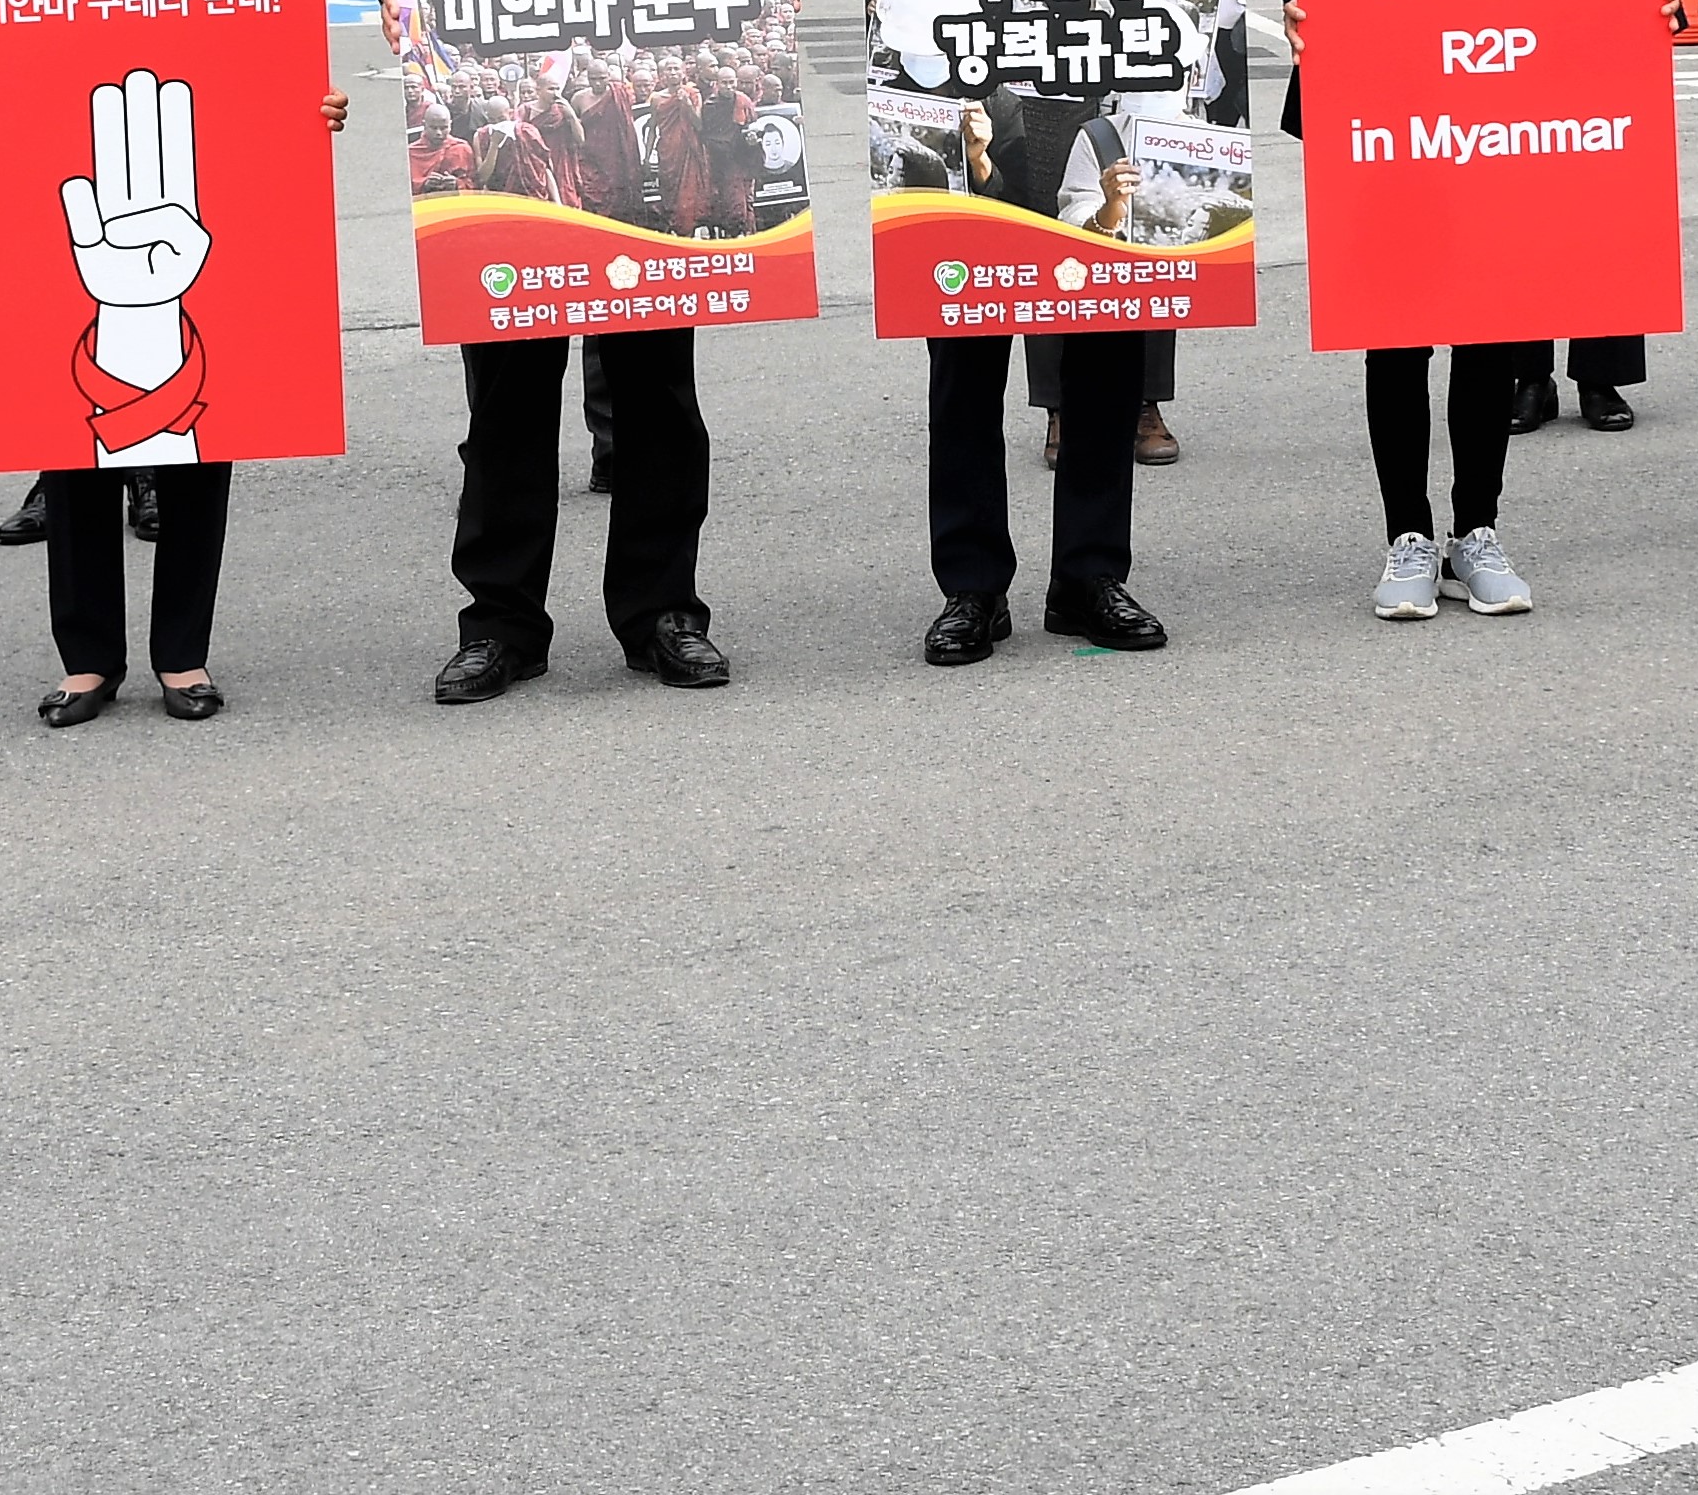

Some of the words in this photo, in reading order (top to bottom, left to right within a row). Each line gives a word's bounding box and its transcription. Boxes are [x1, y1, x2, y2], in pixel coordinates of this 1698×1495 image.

[942, 17, 1173, 85] 강력규탄
[1443, 28, 1536, 73] R2P
[1352, 119, 1393, 161] in
[1411, 115, 1631, 164] Myanmar
[521, 264, 589, 289] 함평군
[644, 253, 754, 280] 함평군의회
[973, 265, 1038, 287] 함평군
[1091, 260, 1196, 283] 함평군의회
[491, 304, 557, 329] 동남아
[566, 294, 697, 323] 결혼이주여성
[707, 290, 750, 312] 일동
[942, 303, 1006, 325] 동남아
[1014, 298, 1140, 322] 결혼이주여성
[1150, 297, 1190, 317] 일동
